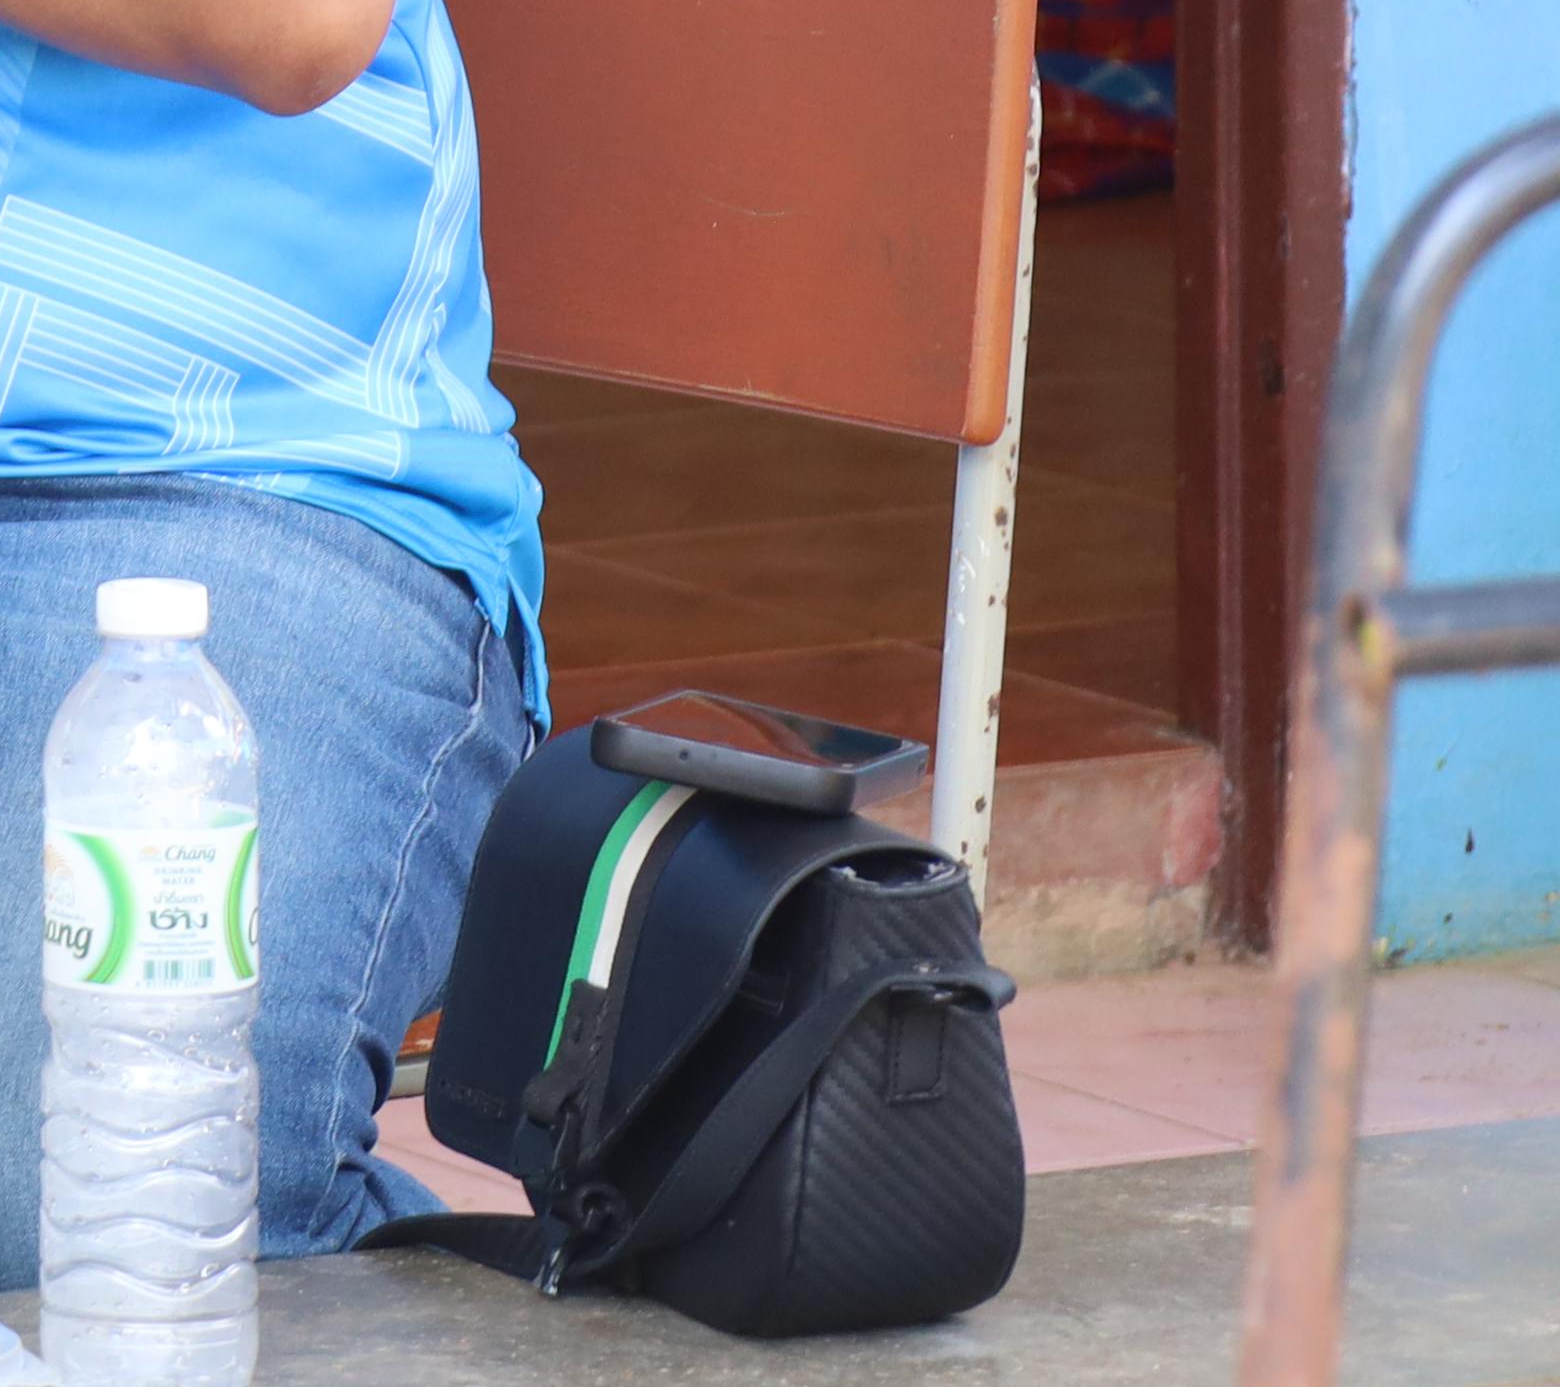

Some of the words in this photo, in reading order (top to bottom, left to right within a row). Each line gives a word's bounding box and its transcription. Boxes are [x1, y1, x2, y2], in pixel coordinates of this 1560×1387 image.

[163, 844, 217, 864] Chang
[148, 907, 209, 931] ช้าง
[44, 916, 93, 959] ang
